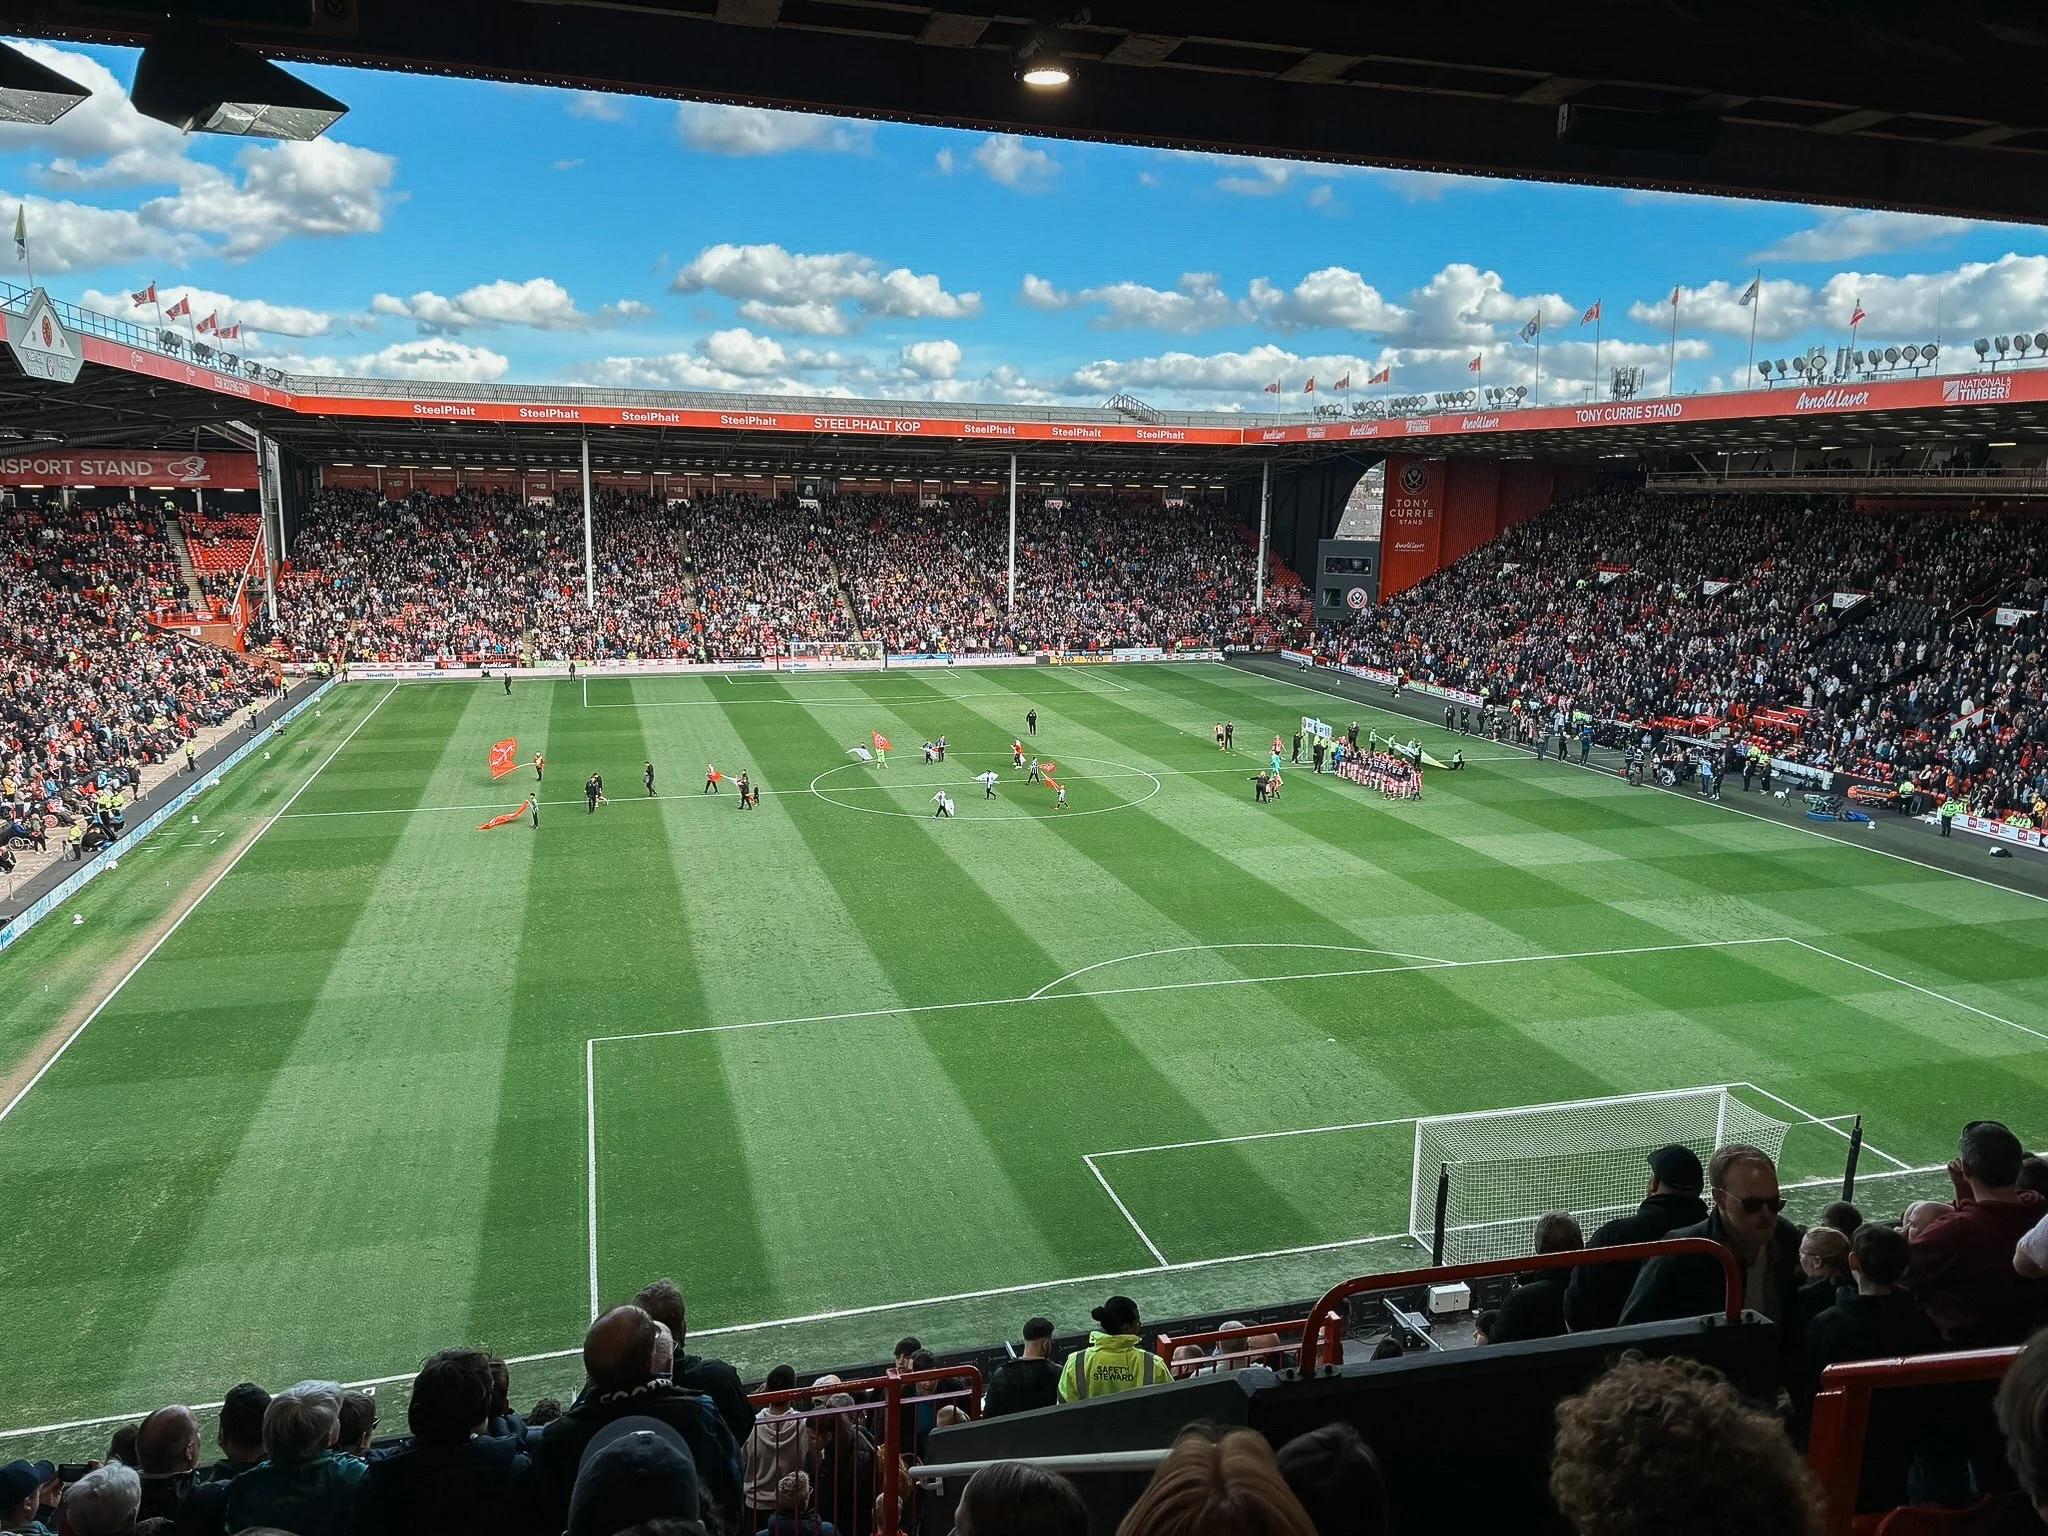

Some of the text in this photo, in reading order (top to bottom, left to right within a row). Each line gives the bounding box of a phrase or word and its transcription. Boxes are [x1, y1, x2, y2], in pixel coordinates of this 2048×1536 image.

[1960, 377, 2005, 388] NATIONAL
[1960, 387, 2005, 400] TIMBER
[1795, 389, 1869, 410] Arnold Laver
[413, 404, 476, 416] SteelPhalt
[519, 408, 580, 419] SteelPhalt
[1576, 403, 1682, 423] TONY CURRIE STAND
[621, 411, 680, 423] SteelPhalt
[720, 415, 777, 426] SteelPhalt
[814, 418, 921, 432] STEELPHALT KOP
[964, 424, 1016, 435] SteelPhalt
[1051, 427, 1102, 438] SteelPhalt
[1136, 429, 1185, 440] SteelPhalt
[80, 460, 153, 476] STAND
[1396, 499, 1429, 508] TONY
[1389, 509, 1434, 518] CURRIE
[1093, 1373, 1134, 1382] STEWARD
